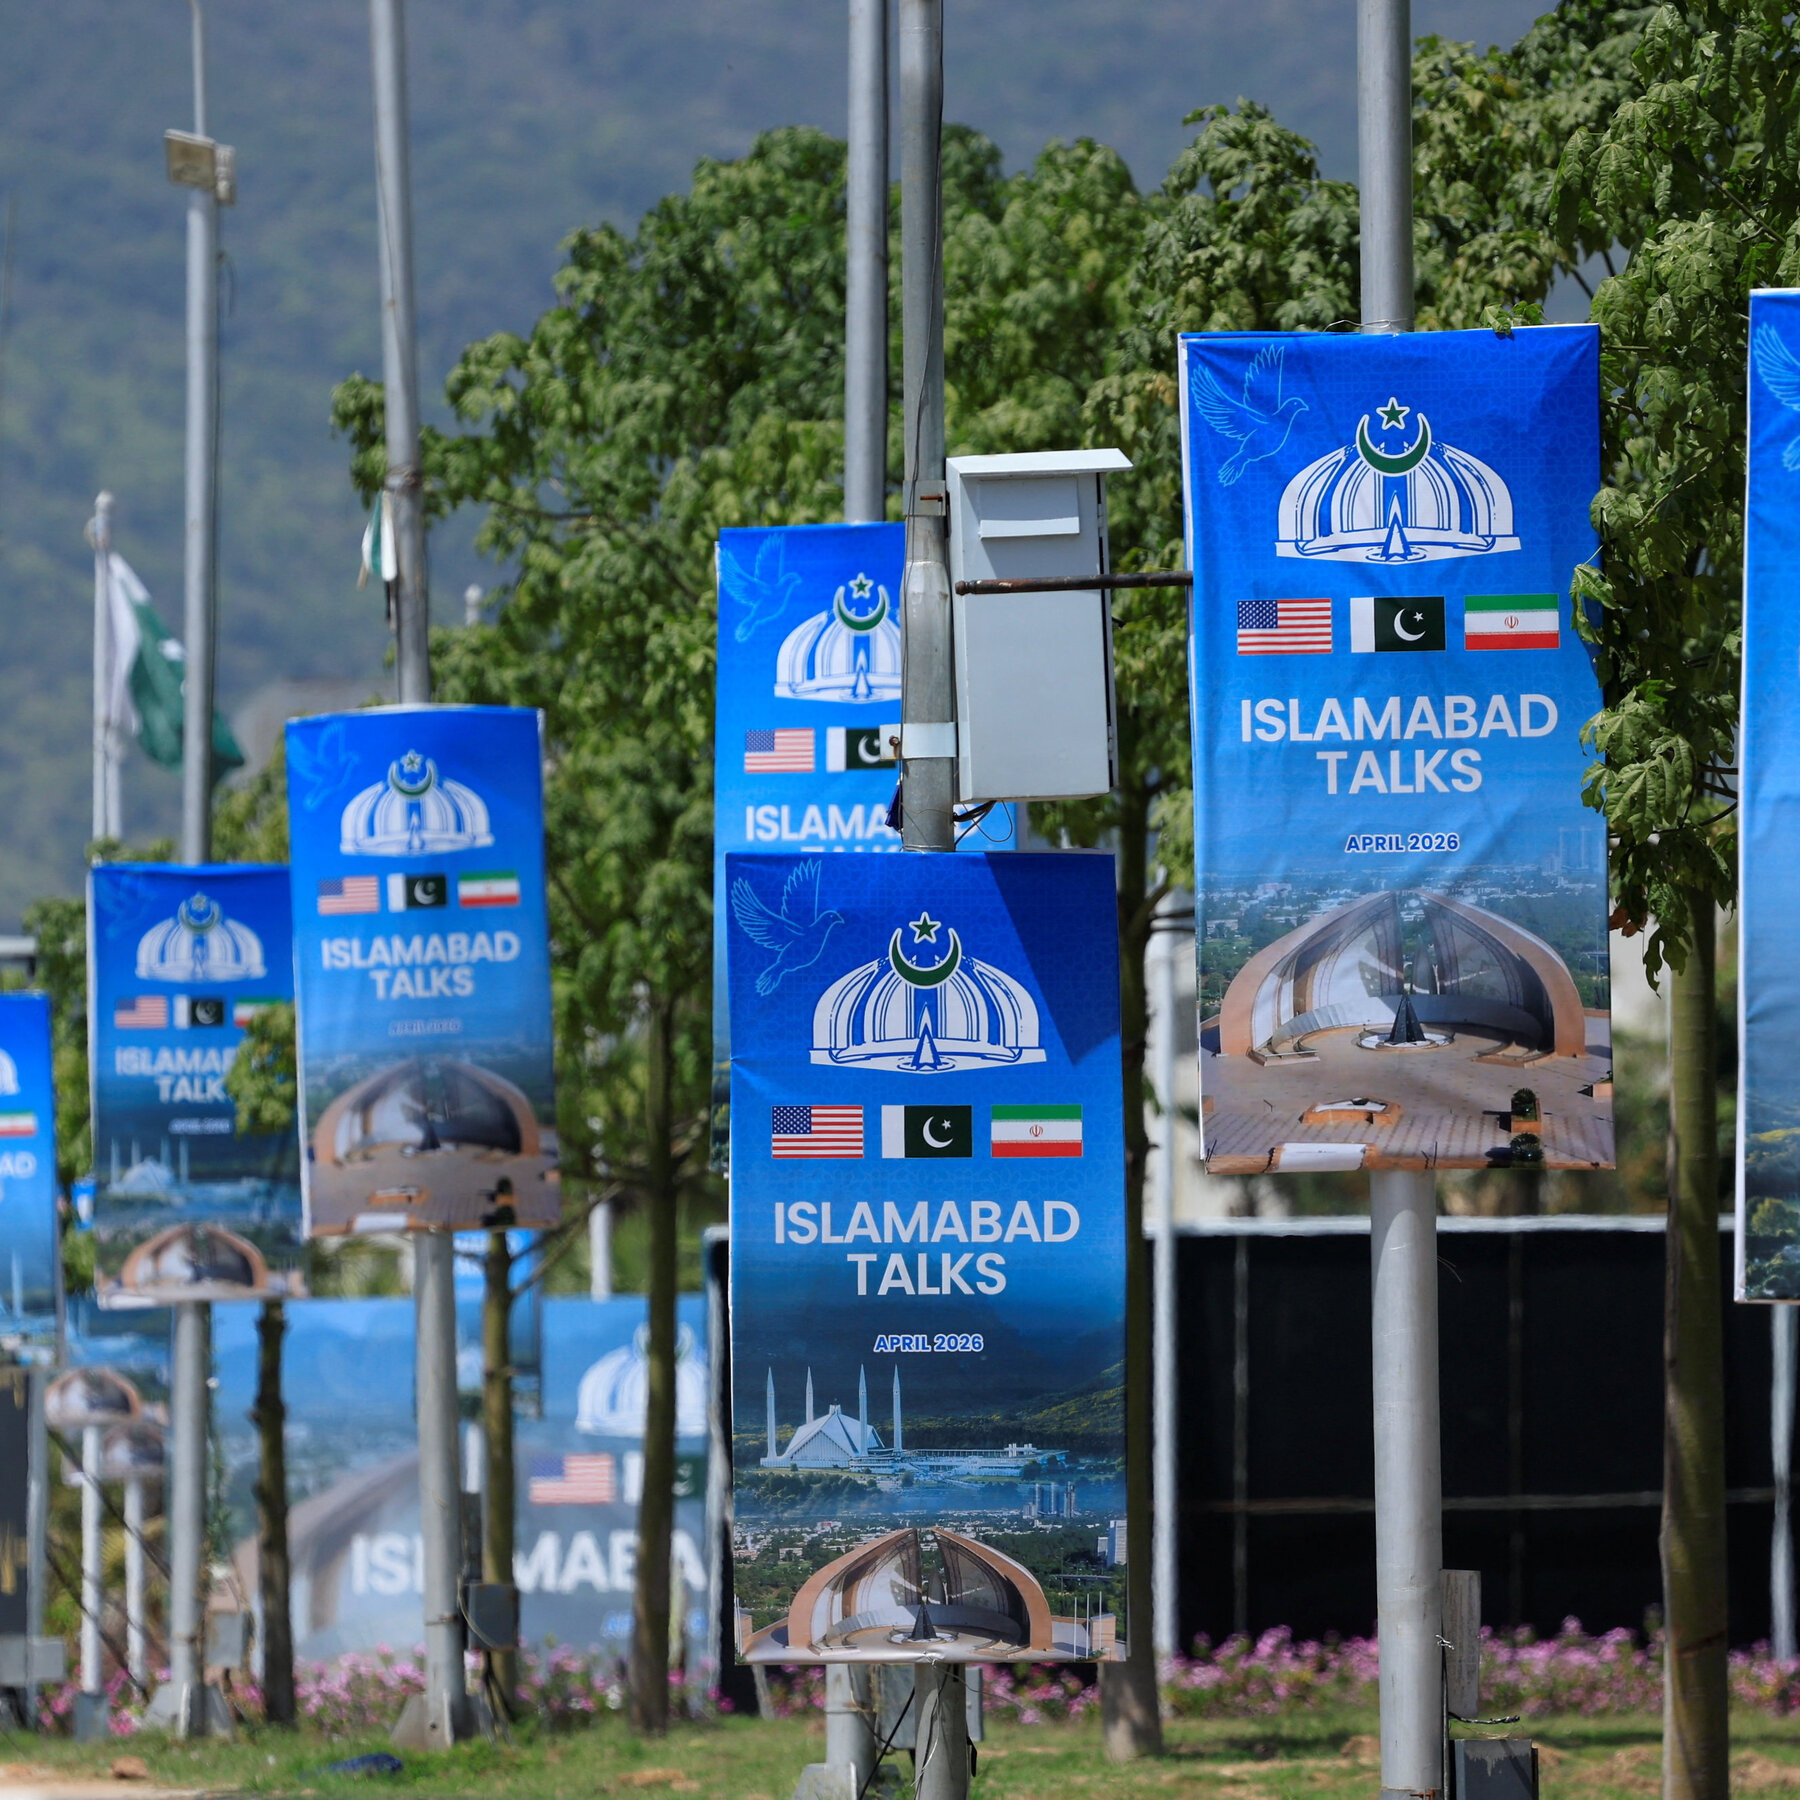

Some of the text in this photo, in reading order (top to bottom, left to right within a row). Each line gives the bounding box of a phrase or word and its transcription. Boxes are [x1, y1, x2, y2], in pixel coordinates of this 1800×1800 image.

[1241, 693, 1559, 742] ISLAMABAD
[1316, 748, 1483, 795] TALKS
[1344, 832, 1461, 853] APRIL 2026
[321, 930, 521, 970] ISLAMABAD
[368, 965, 475, 999] TALKS
[156, 1074, 230, 1104] TALK
[774, 1200, 1081, 1245] ISLAMABAD
[847, 1252, 1007, 1296] TALKS
[873, 1333, 984, 1352] APRIL 2026
